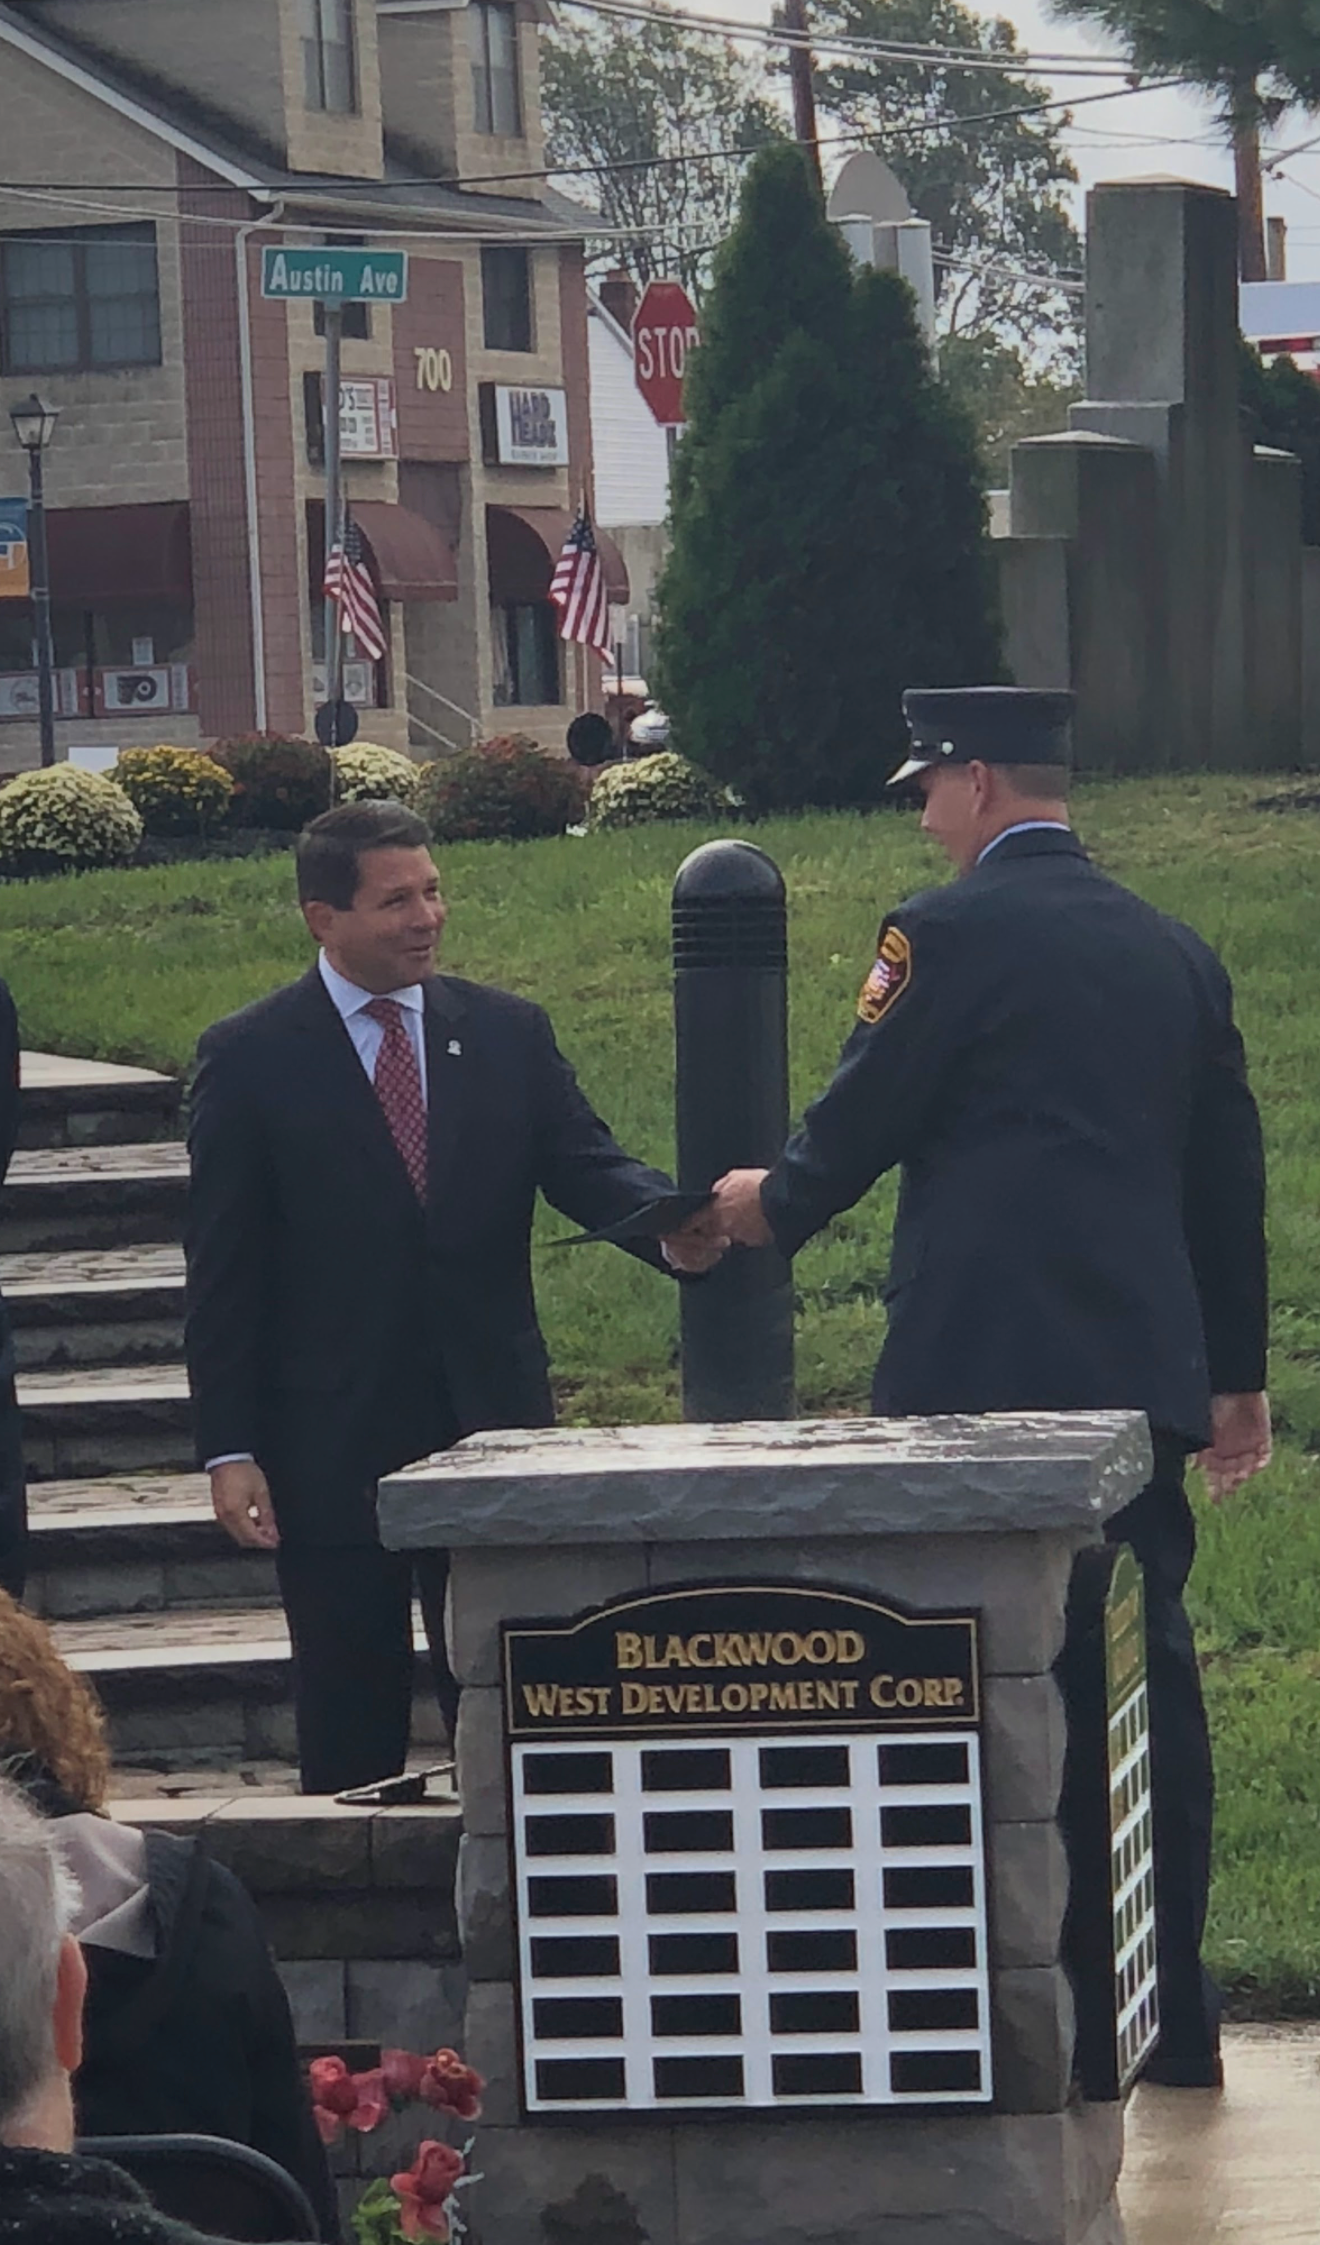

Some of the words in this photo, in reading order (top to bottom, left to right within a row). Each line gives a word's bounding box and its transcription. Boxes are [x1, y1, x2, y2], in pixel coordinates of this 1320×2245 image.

[269, 253, 344, 292] Austin
[359, 264, 398, 294] Ave
[414, 347, 452, 392] 700
